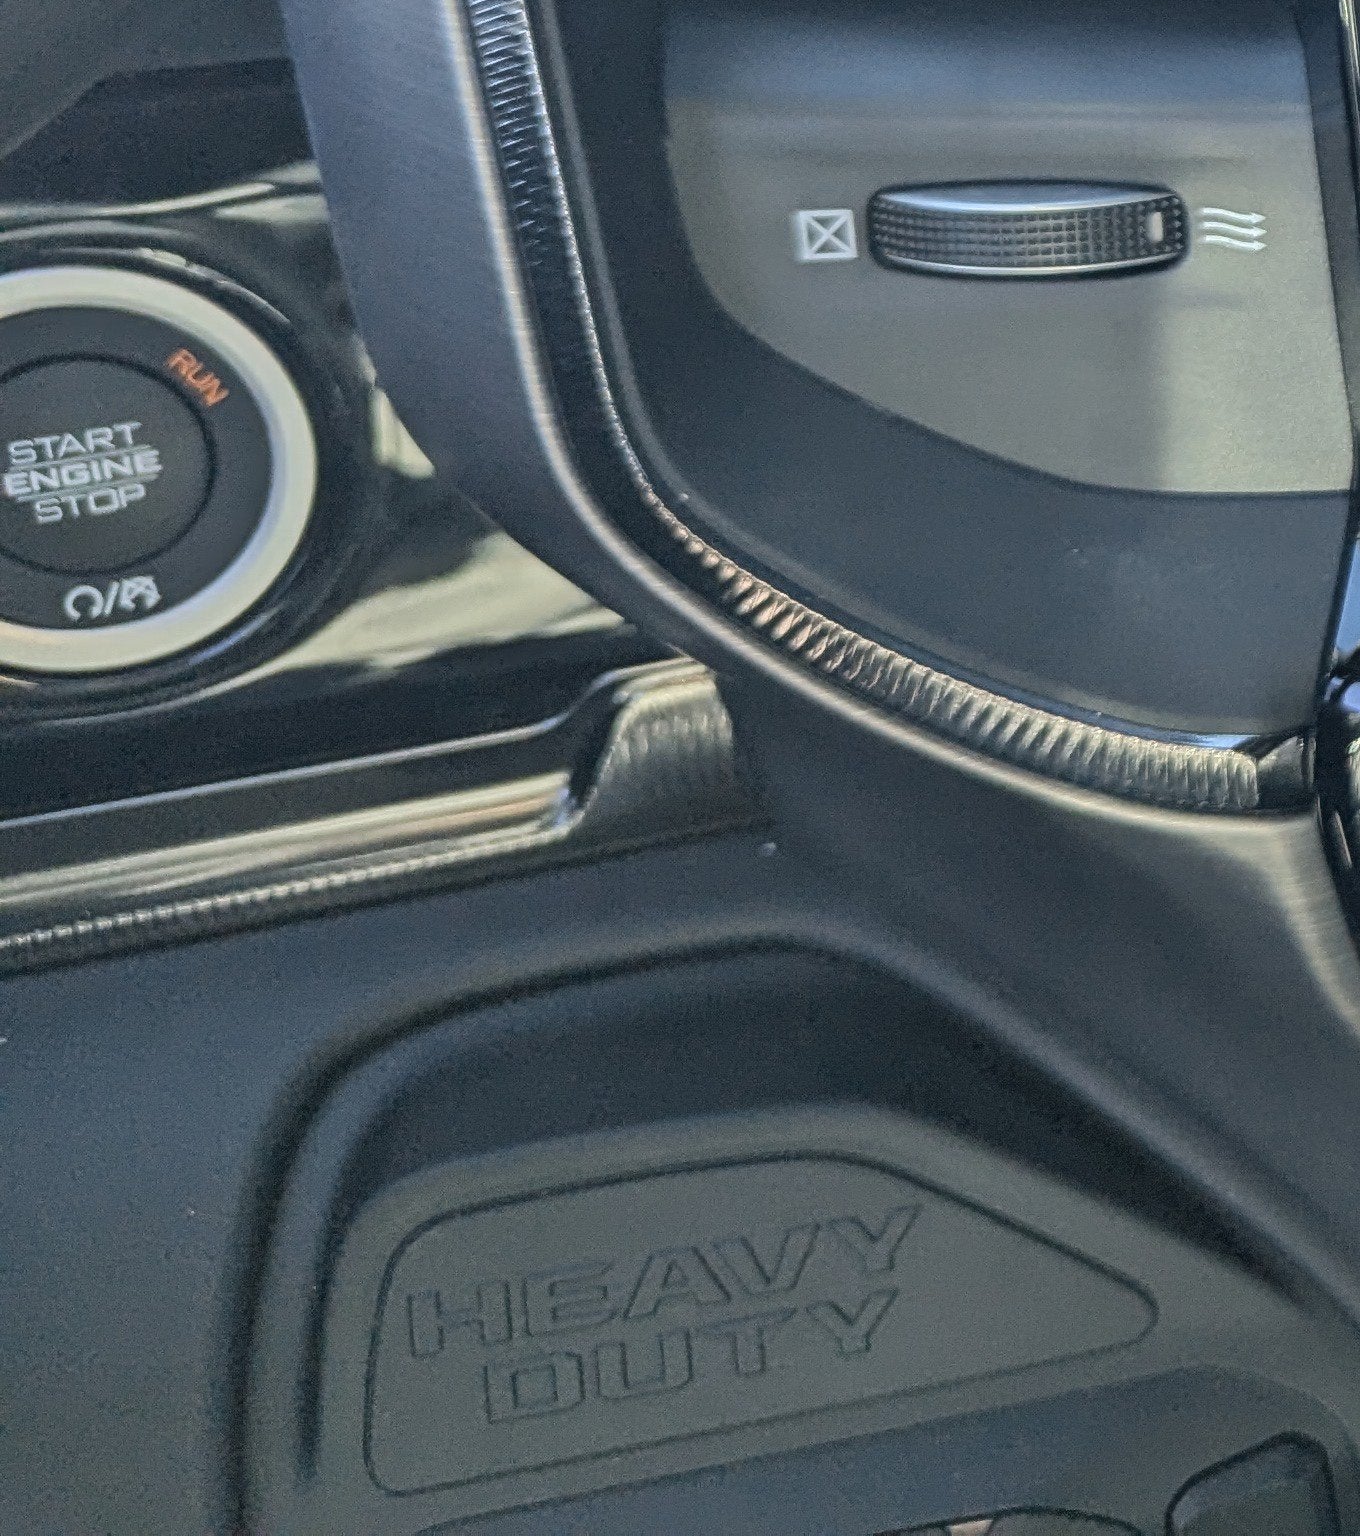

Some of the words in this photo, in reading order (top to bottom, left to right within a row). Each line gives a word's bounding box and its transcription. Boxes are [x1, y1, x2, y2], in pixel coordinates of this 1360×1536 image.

[167, 347, 230, 407] RUN
[7, 420, 145, 466] START
[2, 449, 163, 498] ENGINE
[33, 482, 148, 525] STOP
[405, 1201, 925, 1360] HEAVY
[481, 1287, 900, 1426] DUTY
